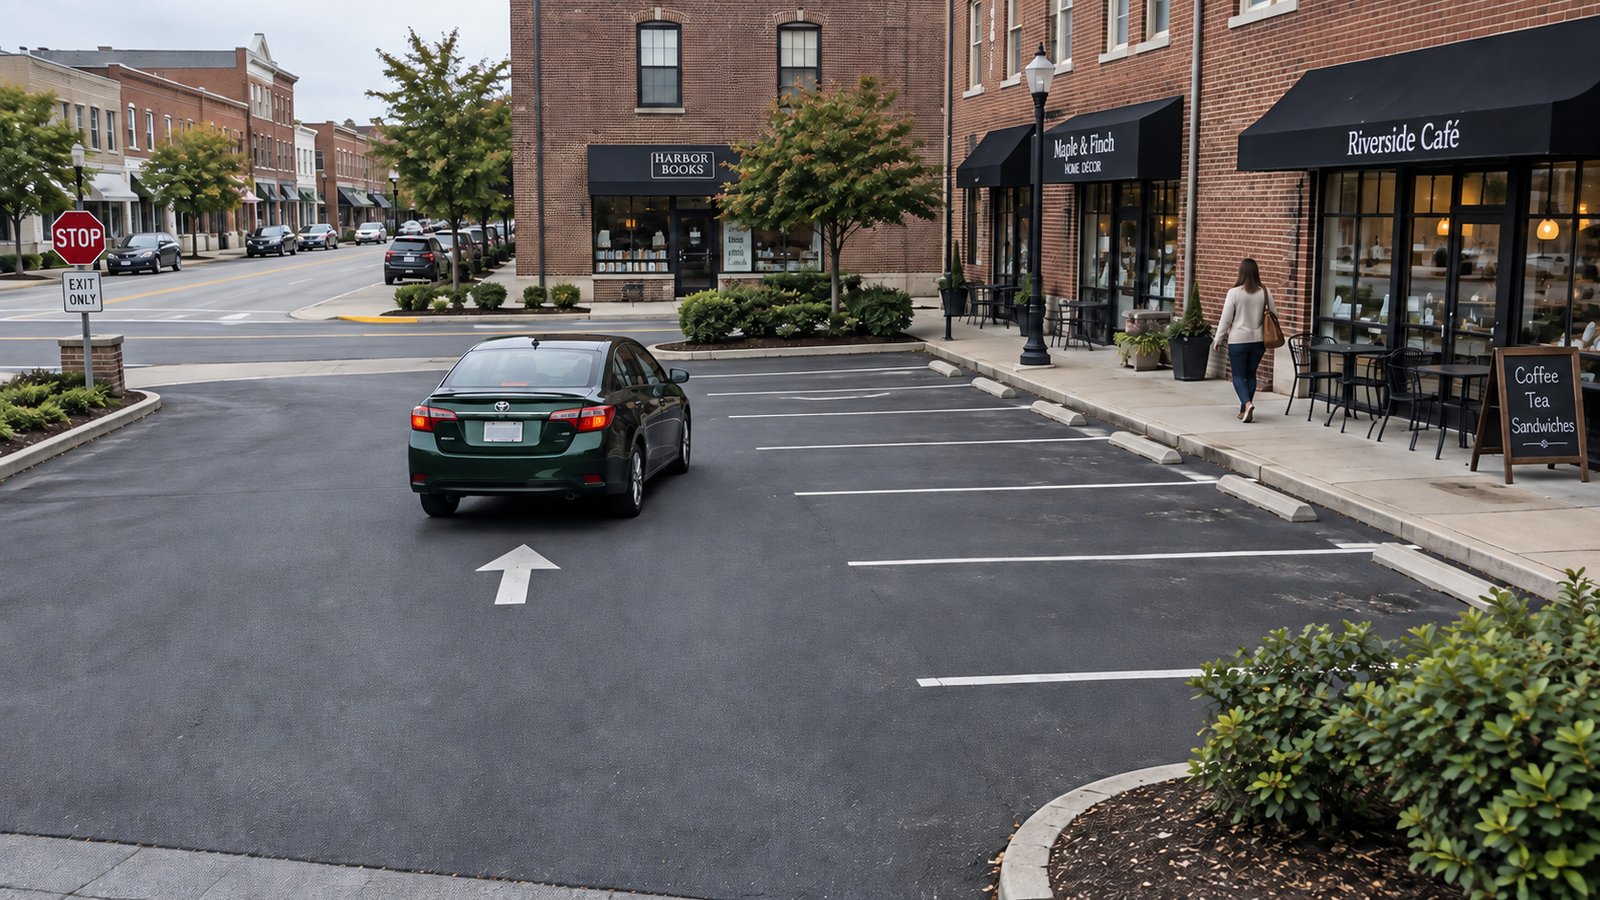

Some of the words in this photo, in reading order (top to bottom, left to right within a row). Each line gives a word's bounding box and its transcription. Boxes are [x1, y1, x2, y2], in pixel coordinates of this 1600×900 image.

[1347, 124, 1416, 155] Riverside
[1421, 119, 1460, 150] Café
[1053, 136, 1078, 161] Maple
[1080, 136, 1088, 155] &
[1090, 131, 1115, 154] Finch
[655, 153, 708, 163] HARBOR
[662, 164, 704, 174] BOOKS
[56, 228, 101, 248] STOP
[69, 278, 95, 290] EXIT
[69, 294, 96, 305] ONLY
[1515, 366, 1560, 384] Coffee
[1525, 391, 1550, 408] Tea
[1511, 417, 1575, 434] Sandwiches
